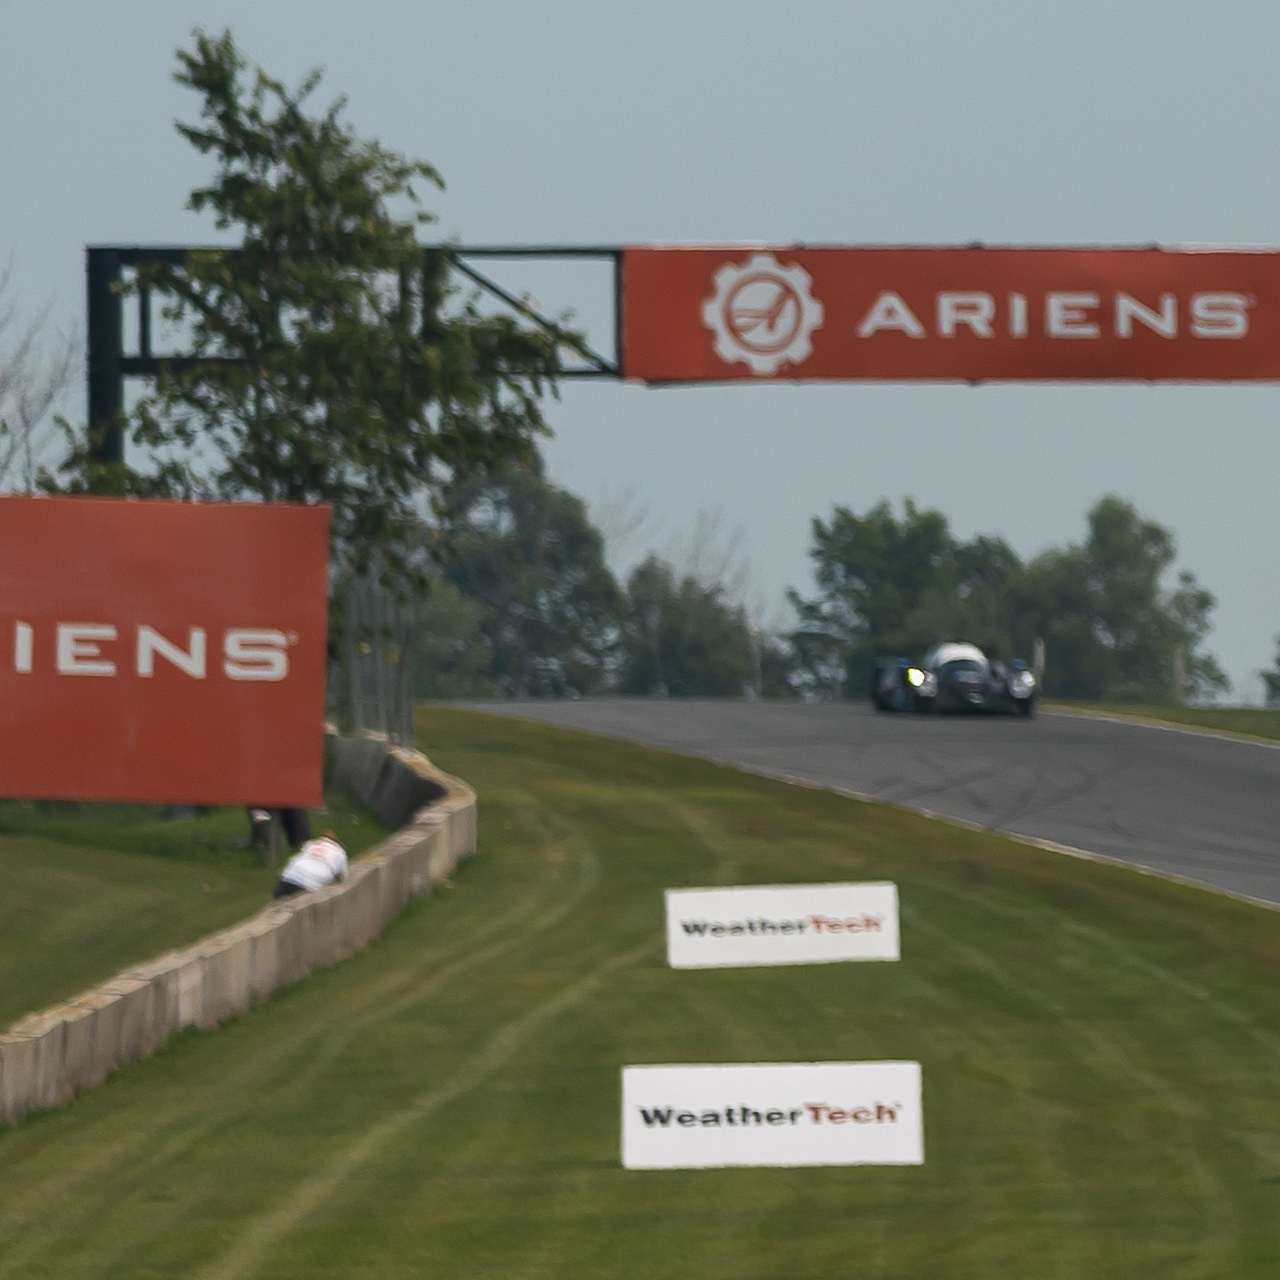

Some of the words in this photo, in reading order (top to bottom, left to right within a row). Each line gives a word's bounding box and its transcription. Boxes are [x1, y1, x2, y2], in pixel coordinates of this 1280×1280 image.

[857, 291, 1250, 339] ARIENS
[15, 621, 289, 681] IENS
[681, 914, 883, 938] WeatherTech
[640, 1102, 899, 1129] WeatherTech
